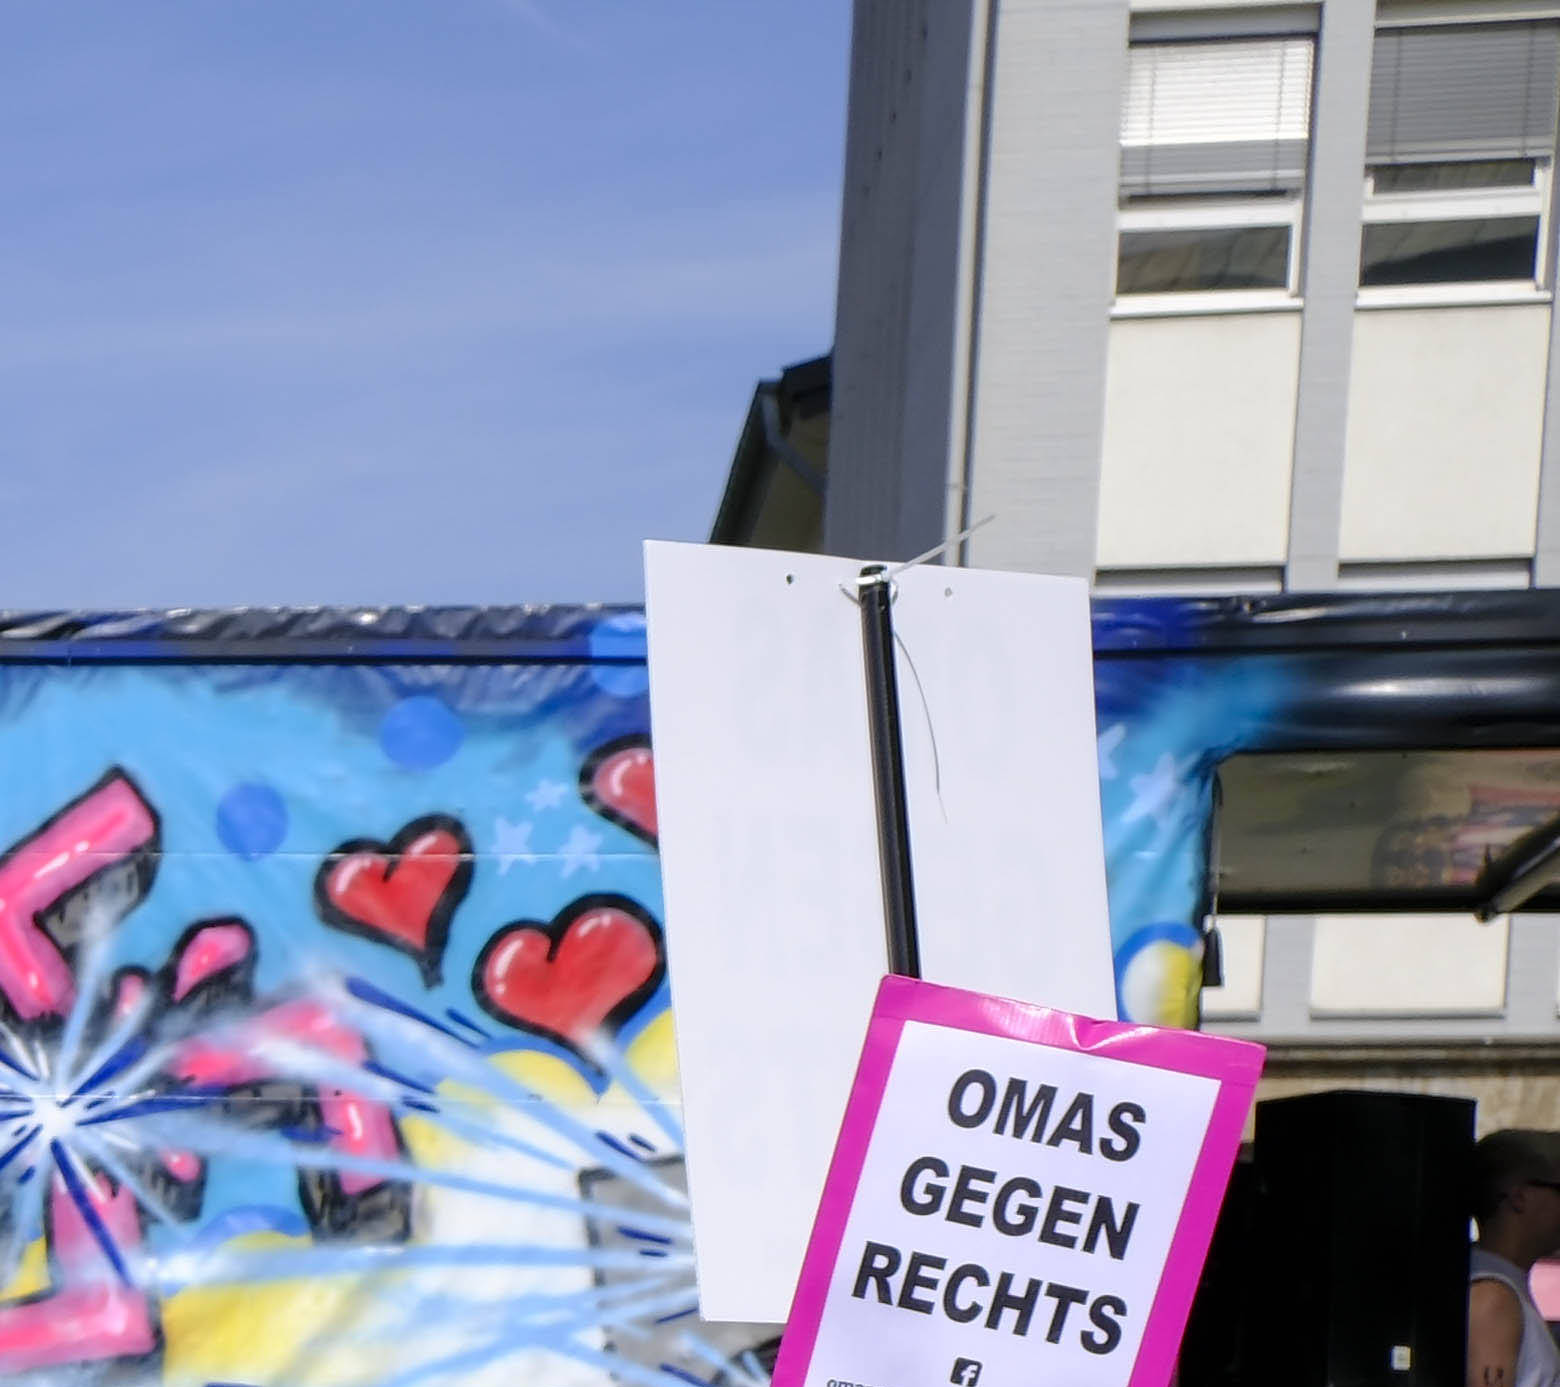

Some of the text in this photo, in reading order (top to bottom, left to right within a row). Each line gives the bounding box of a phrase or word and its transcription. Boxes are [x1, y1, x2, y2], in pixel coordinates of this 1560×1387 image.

[945, 1067, 1148, 1165] OMAS
[898, 1153, 1141, 1262] GEGEN
[849, 1239, 1129, 1358] RECHTS
